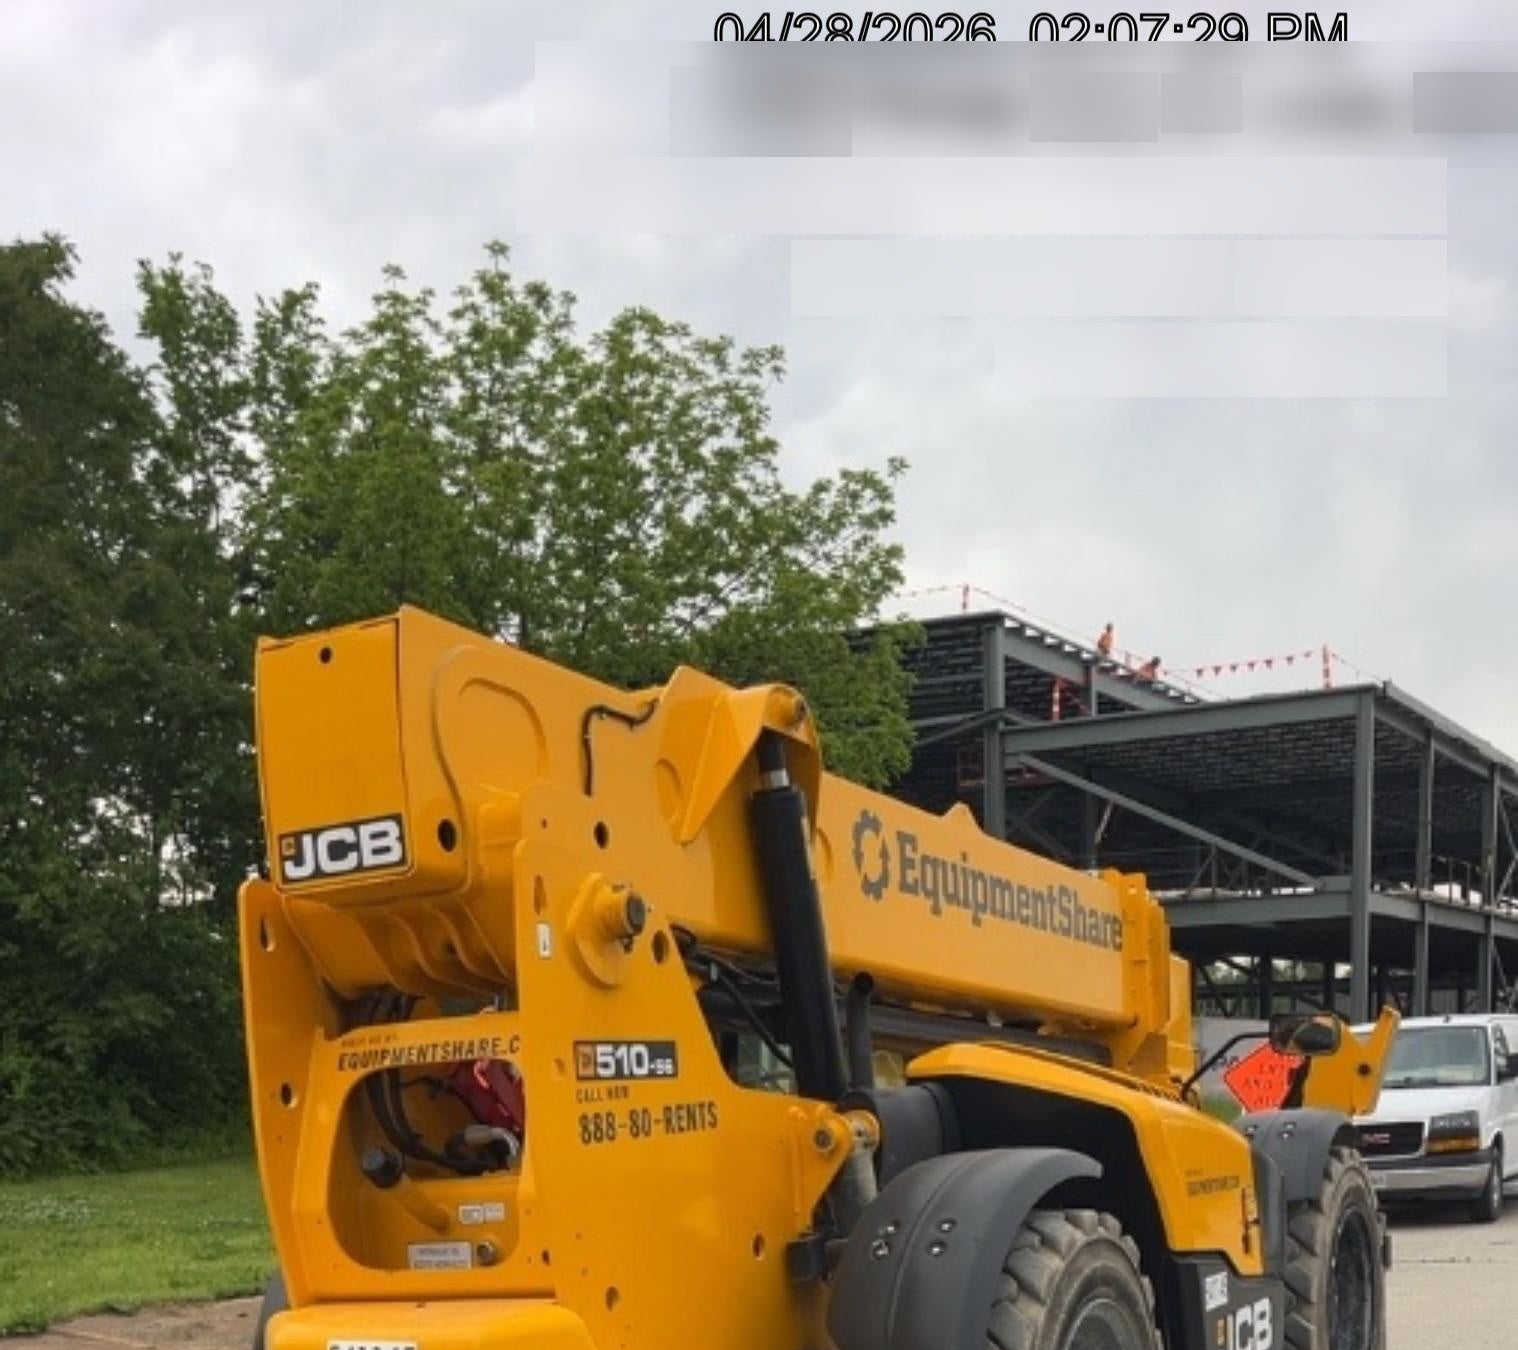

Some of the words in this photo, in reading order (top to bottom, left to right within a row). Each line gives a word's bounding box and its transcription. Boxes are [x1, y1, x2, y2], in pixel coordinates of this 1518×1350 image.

[283, 819, 403, 879] JCB
[896, 830, 1123, 952] EquipmentShare
[578, 1100, 719, 1145] 888-80-RENTS
